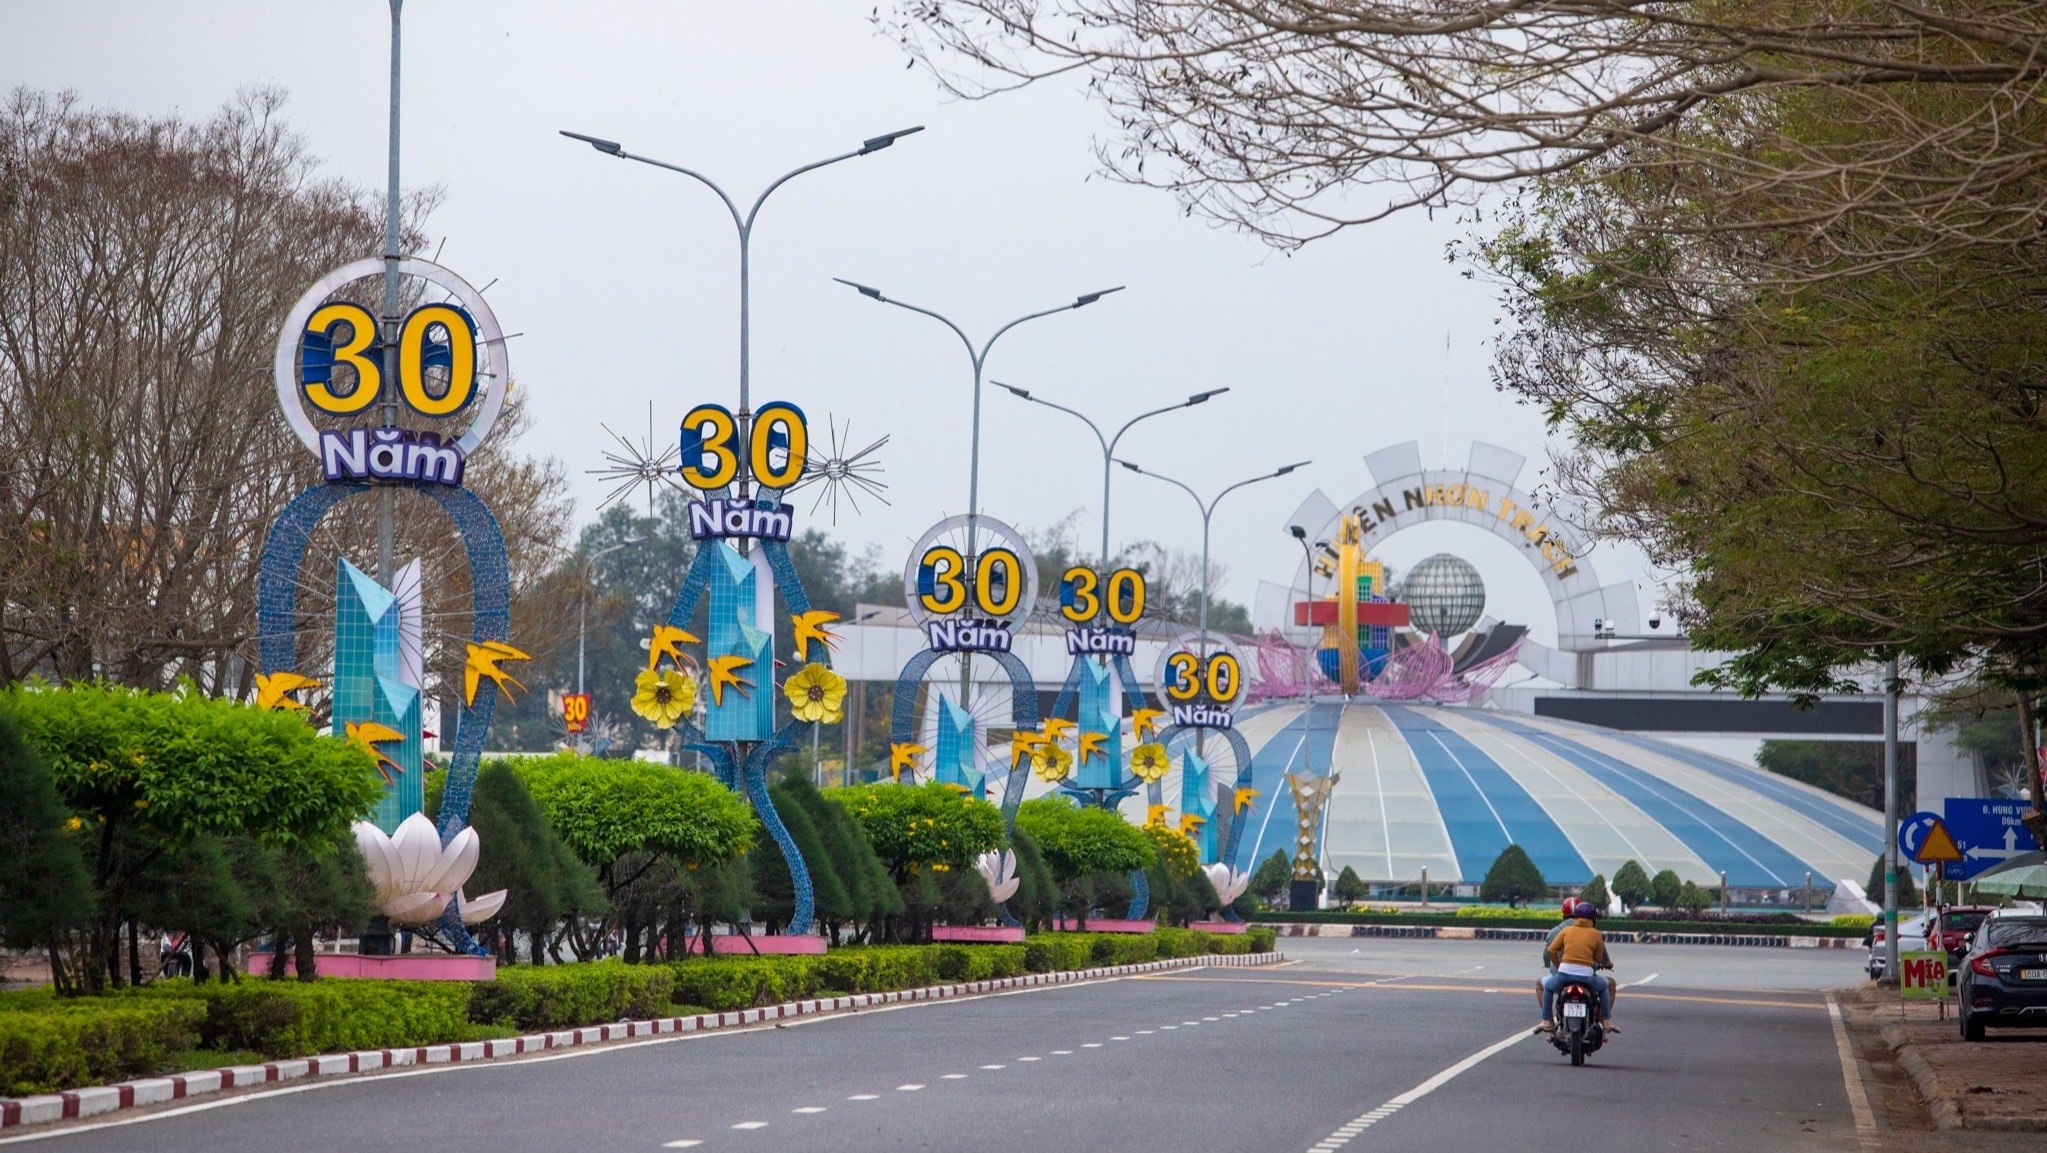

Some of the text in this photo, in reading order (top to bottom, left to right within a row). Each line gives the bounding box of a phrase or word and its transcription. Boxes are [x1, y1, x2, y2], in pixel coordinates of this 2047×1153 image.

[302, 301, 478, 418] 30
[321, 428, 460, 483] Năm
[681, 404, 808, 489] 30
[689, 499, 791, 539] Năm
[1403, 483, 1489, 512] NHƠN
[919, 547, 1021, 615] 30
[1061, 567, 1146, 623] 30
[929, 620, 1011, 650] Năm
[1067, 628, 1134, 652] Năm
[1166, 652, 1240, 702] 30
[565, 696, 587, 721] 30
[1173, 704, 1231, 727] Năm
